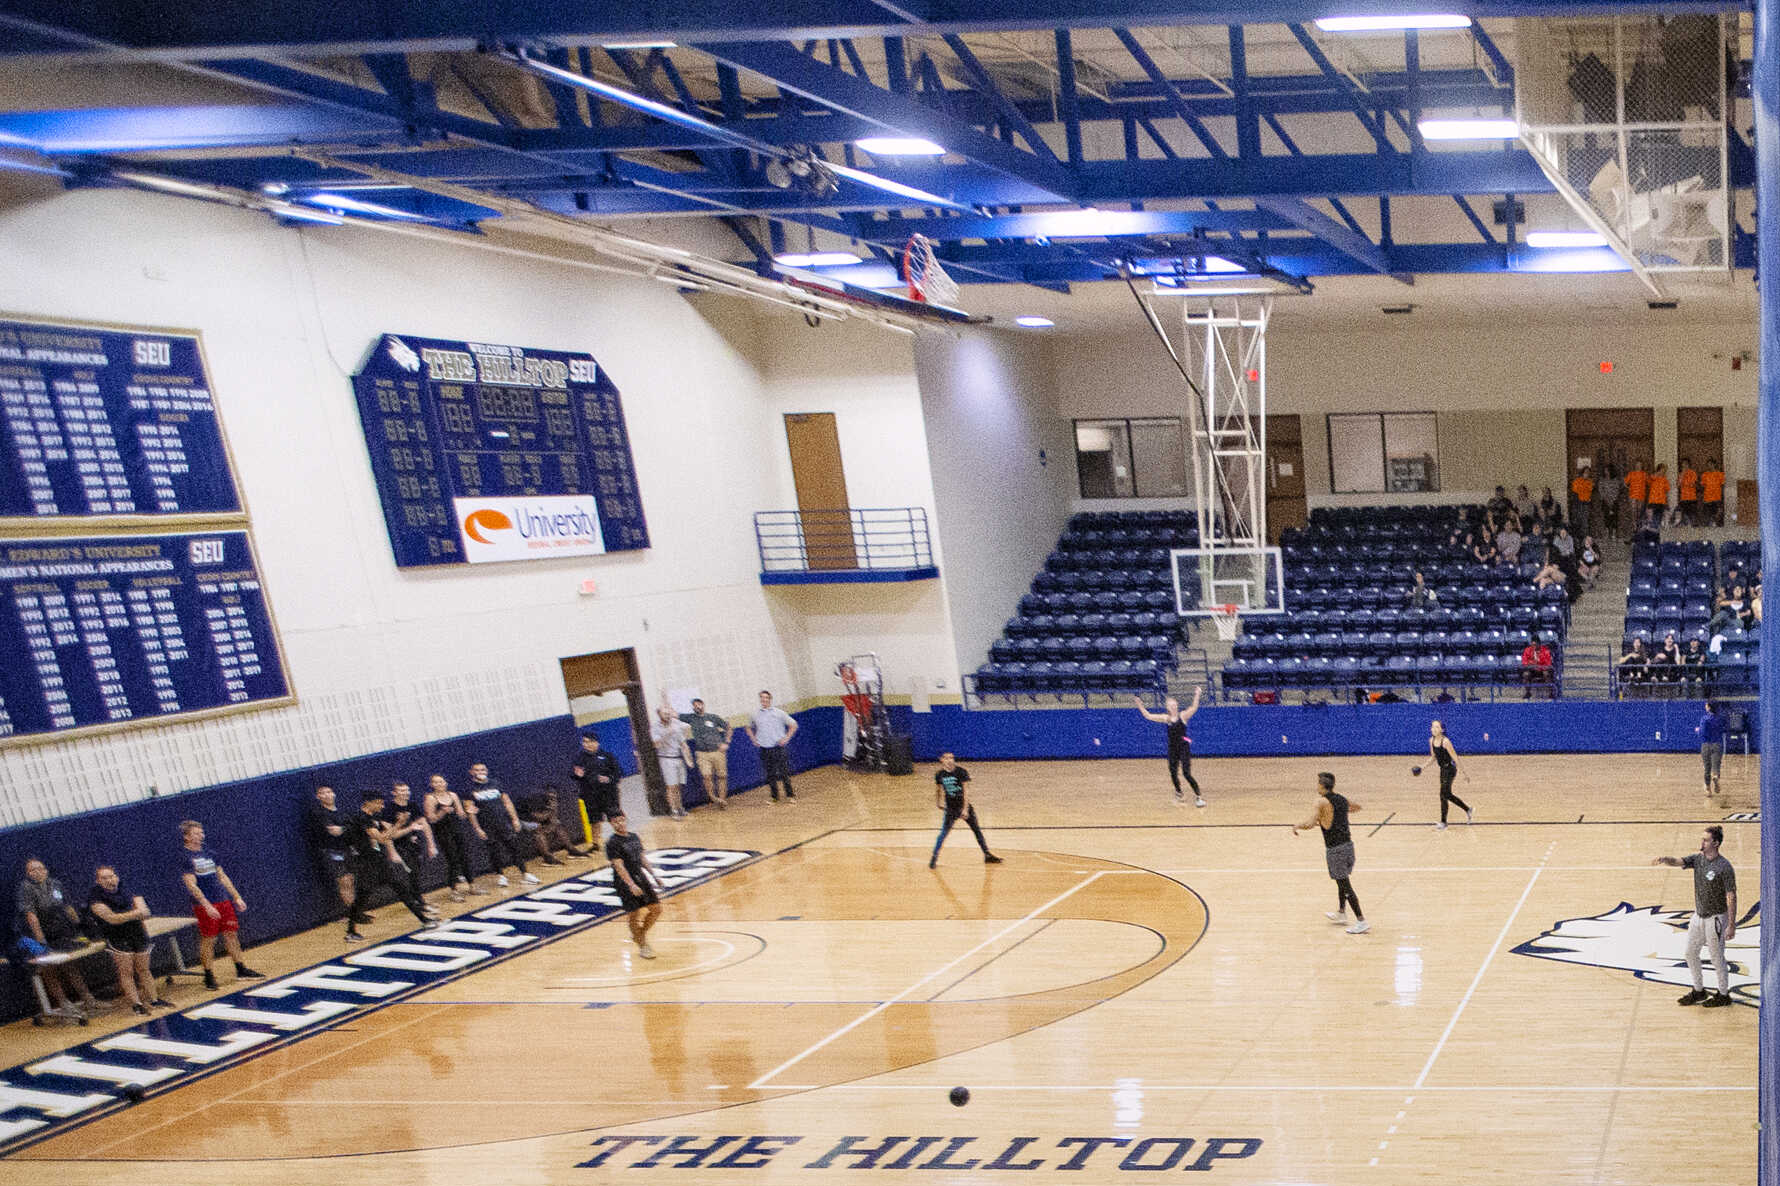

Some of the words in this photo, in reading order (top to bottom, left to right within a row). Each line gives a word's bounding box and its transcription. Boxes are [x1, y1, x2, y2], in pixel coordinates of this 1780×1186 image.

[133, 340, 171, 366] SEU
[420, 347, 477, 383] THE
[476, 353, 570, 389] HILLTOP
[568, 359, 597, 383] SEU
[513, 505, 597, 544] University
[190, 540, 224, 565] SEU
[39, 564, 97, 576] NATIONAL
[99, 559, 174, 573] APPEARANCES
[573, 1135, 802, 1169] THE
[803, 1135, 1265, 1171] HILLTOP
